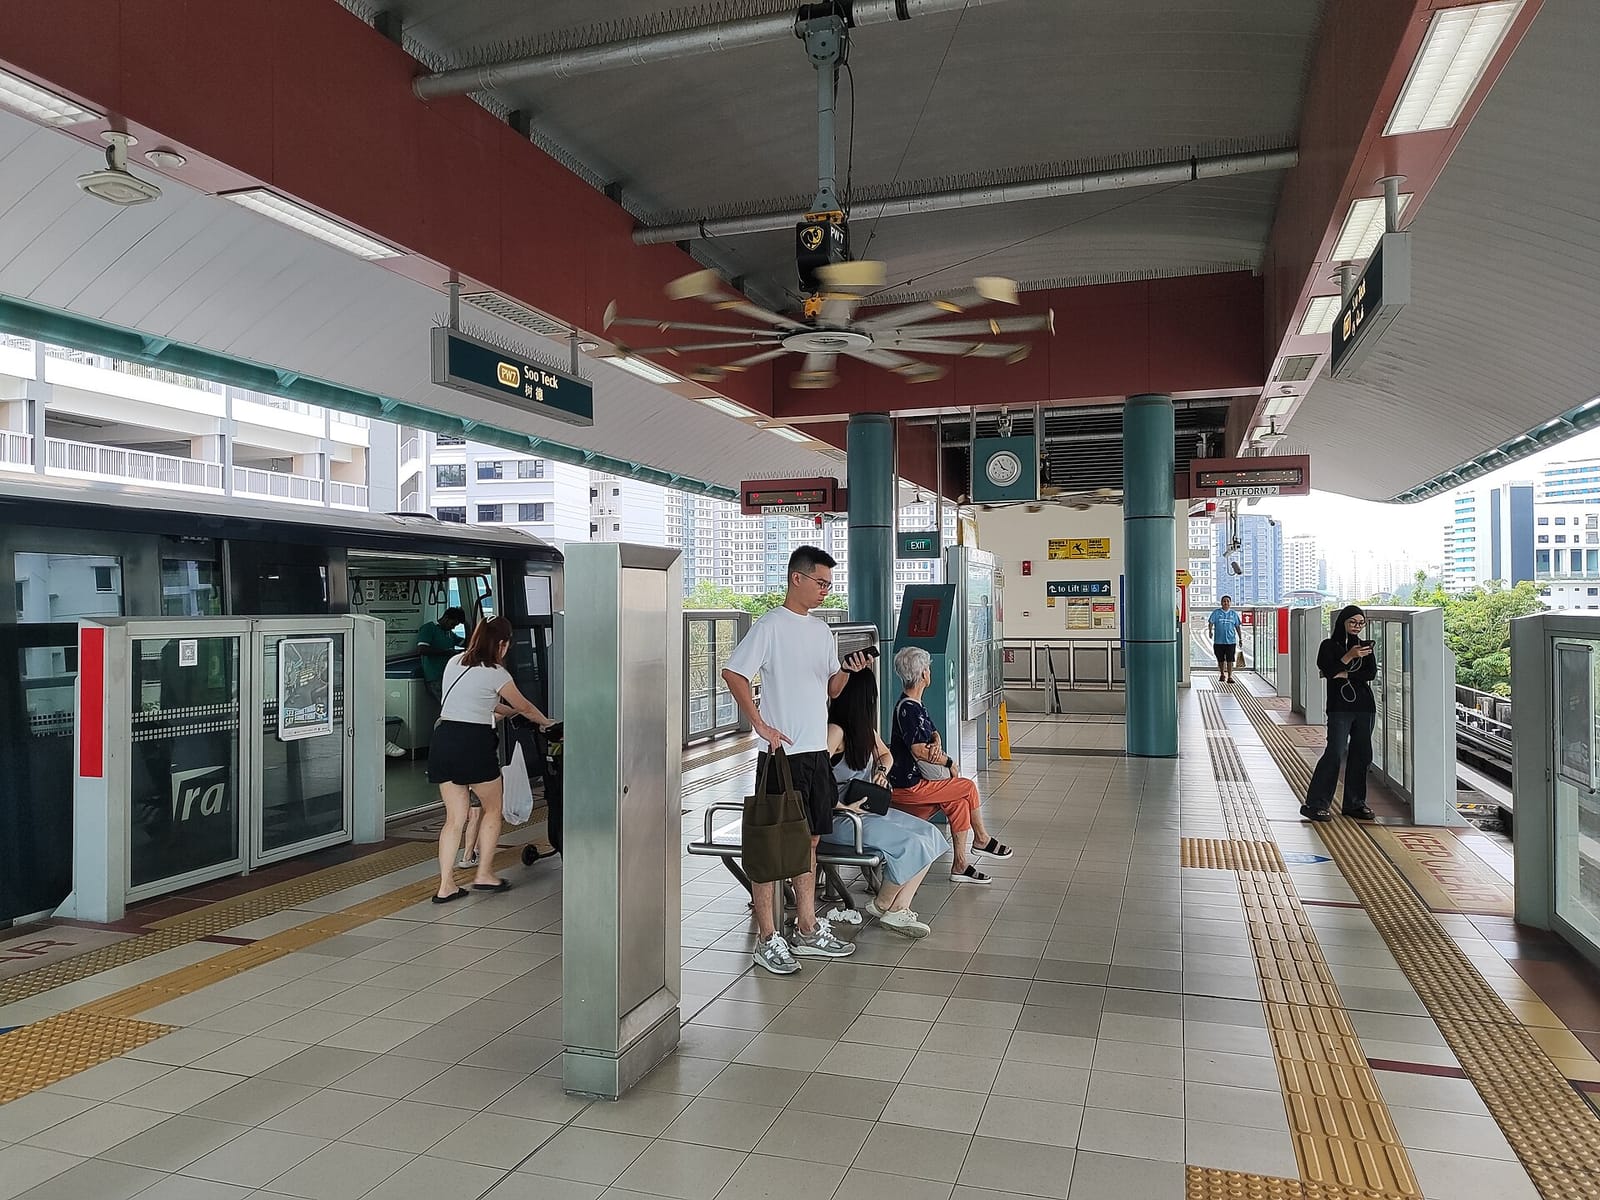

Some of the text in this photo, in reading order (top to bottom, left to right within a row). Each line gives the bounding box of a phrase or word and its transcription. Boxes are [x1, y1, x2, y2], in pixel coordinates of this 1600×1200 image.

[501, 367, 517, 382] PW7
[524, 365, 559, 389] Soo Teck
[1219, 487, 1268, 496] PLATFORM
[763, 505, 801, 513] PLATFORM
[910, 541, 925, 550] EXIT
[1067, 584, 1080, 592] Lift
[1393, 831, 1454, 858] KEEP
[815, 937, 829, 948] N
[764, 949, 775, 960] N
